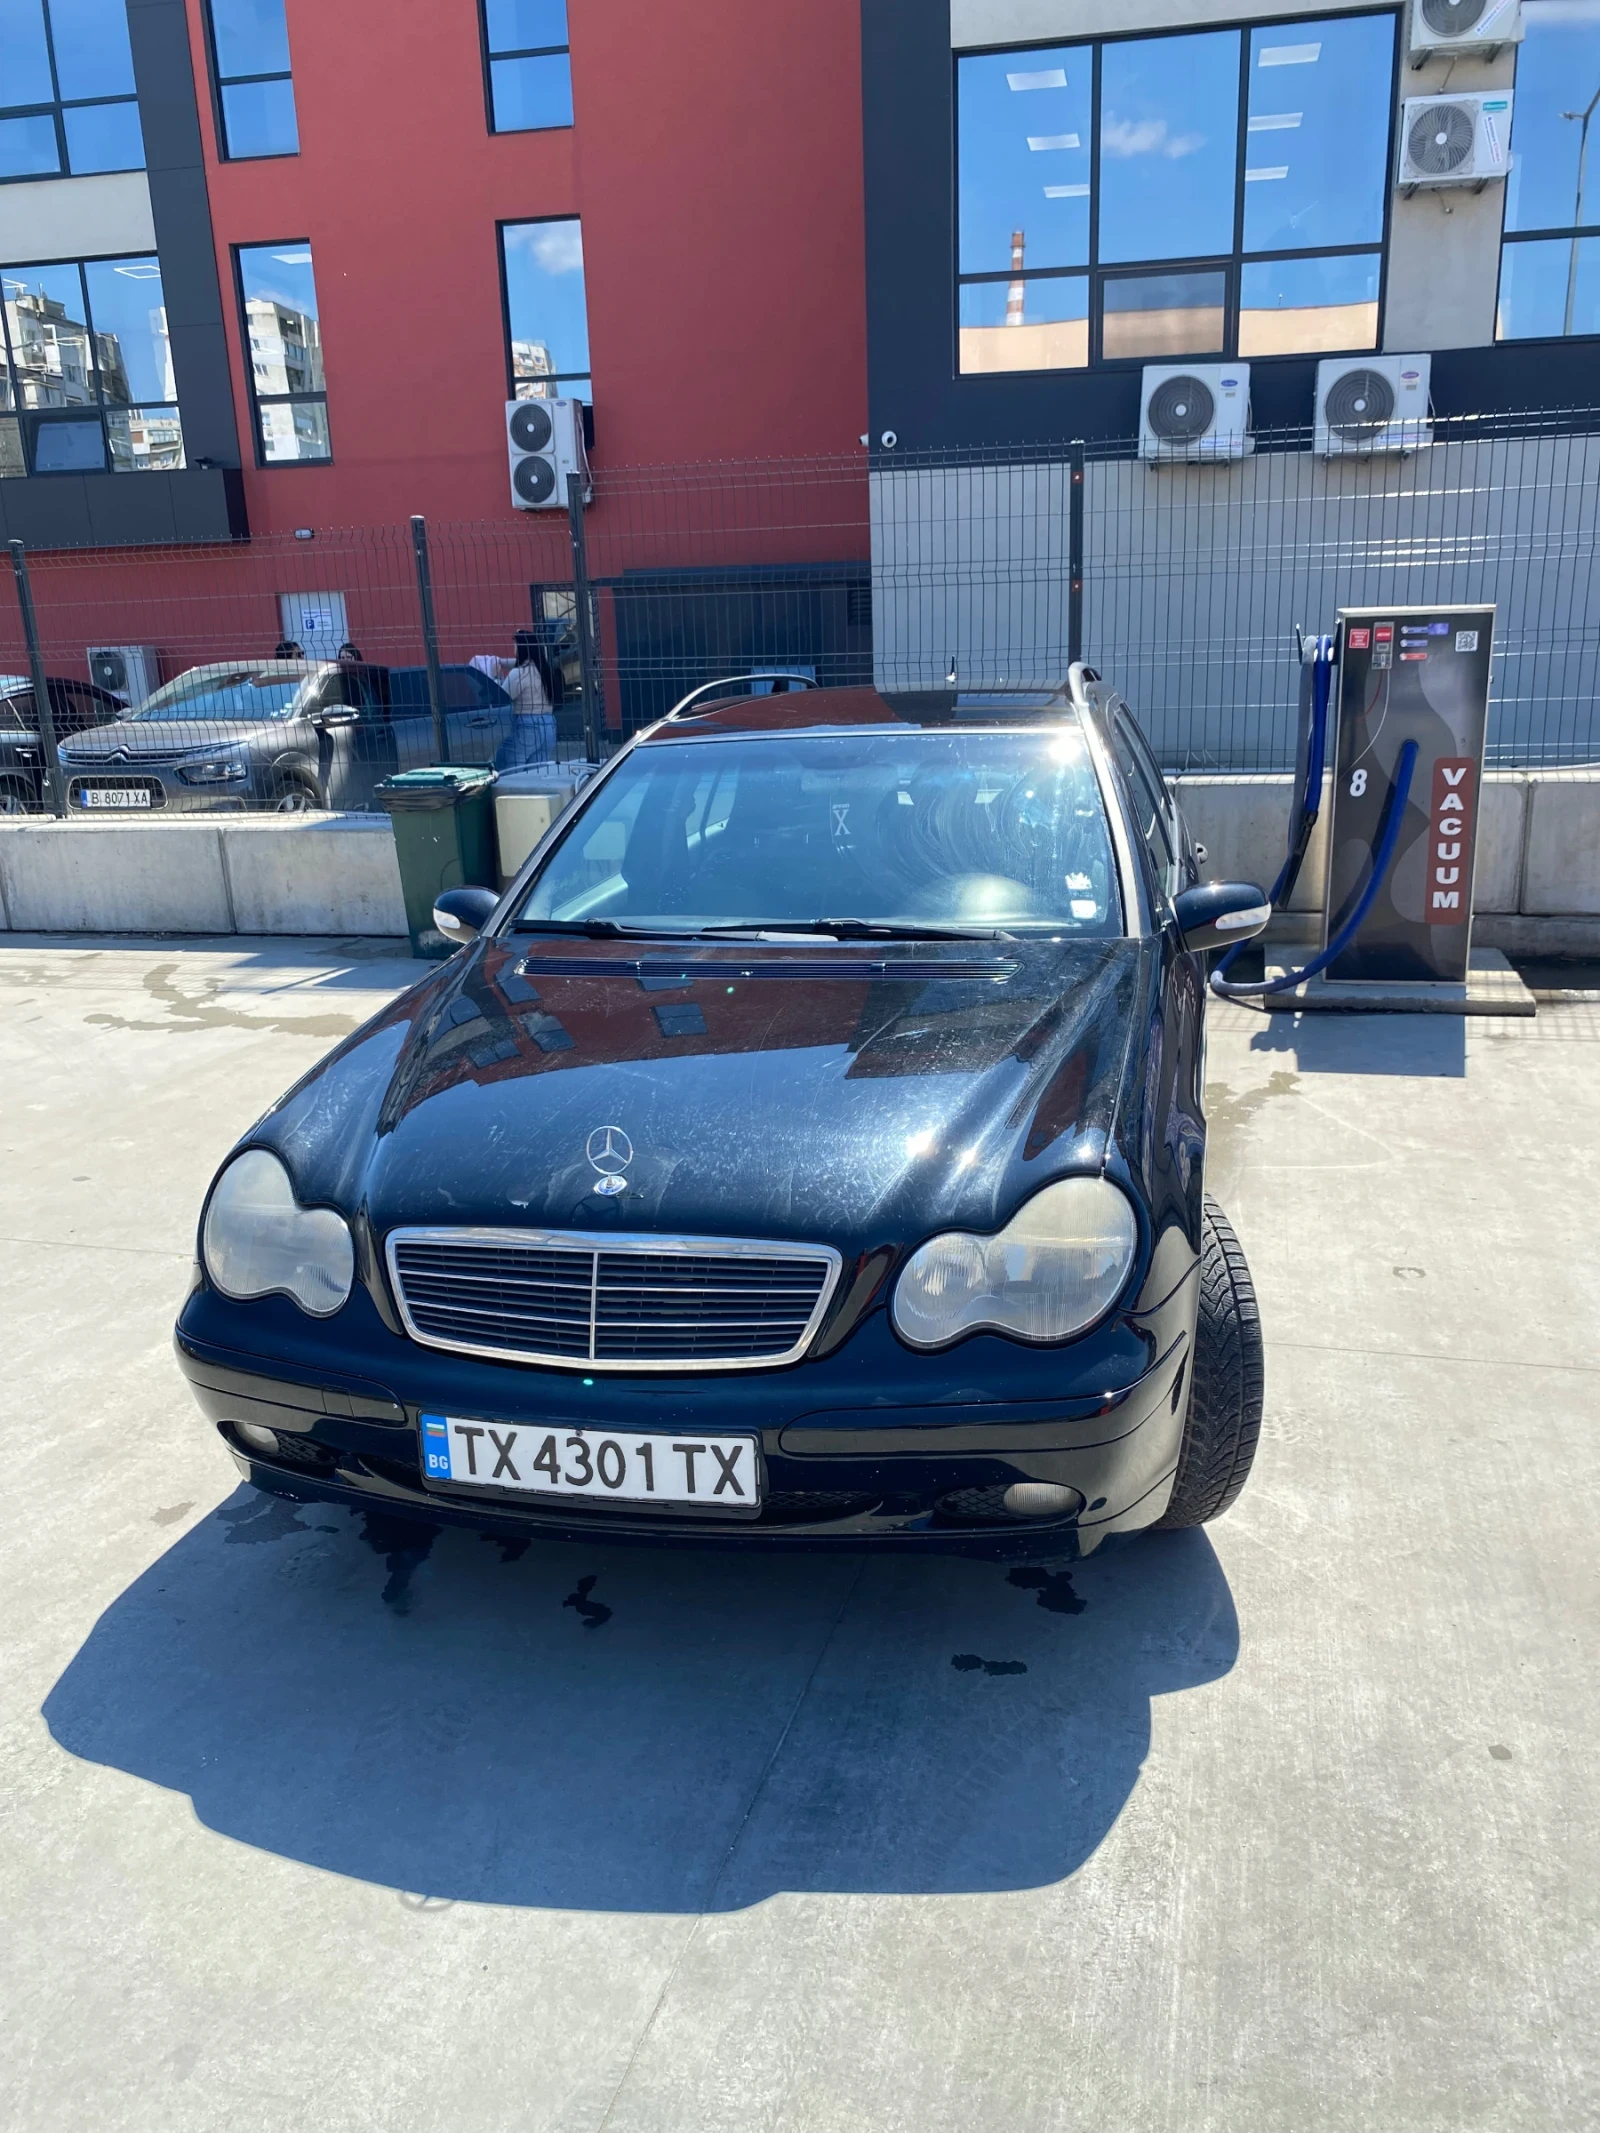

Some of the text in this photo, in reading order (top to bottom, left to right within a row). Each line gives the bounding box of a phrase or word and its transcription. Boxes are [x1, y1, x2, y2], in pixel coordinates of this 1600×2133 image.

[1350, 769, 1367, 797] 8
[92, 792, 148, 804] B 8071 XA
[1432, 767, 1467, 909] VACUUM
[428, 1454, 448, 1470] BG
[455, 1425, 745, 1496] TX 4301 TX
